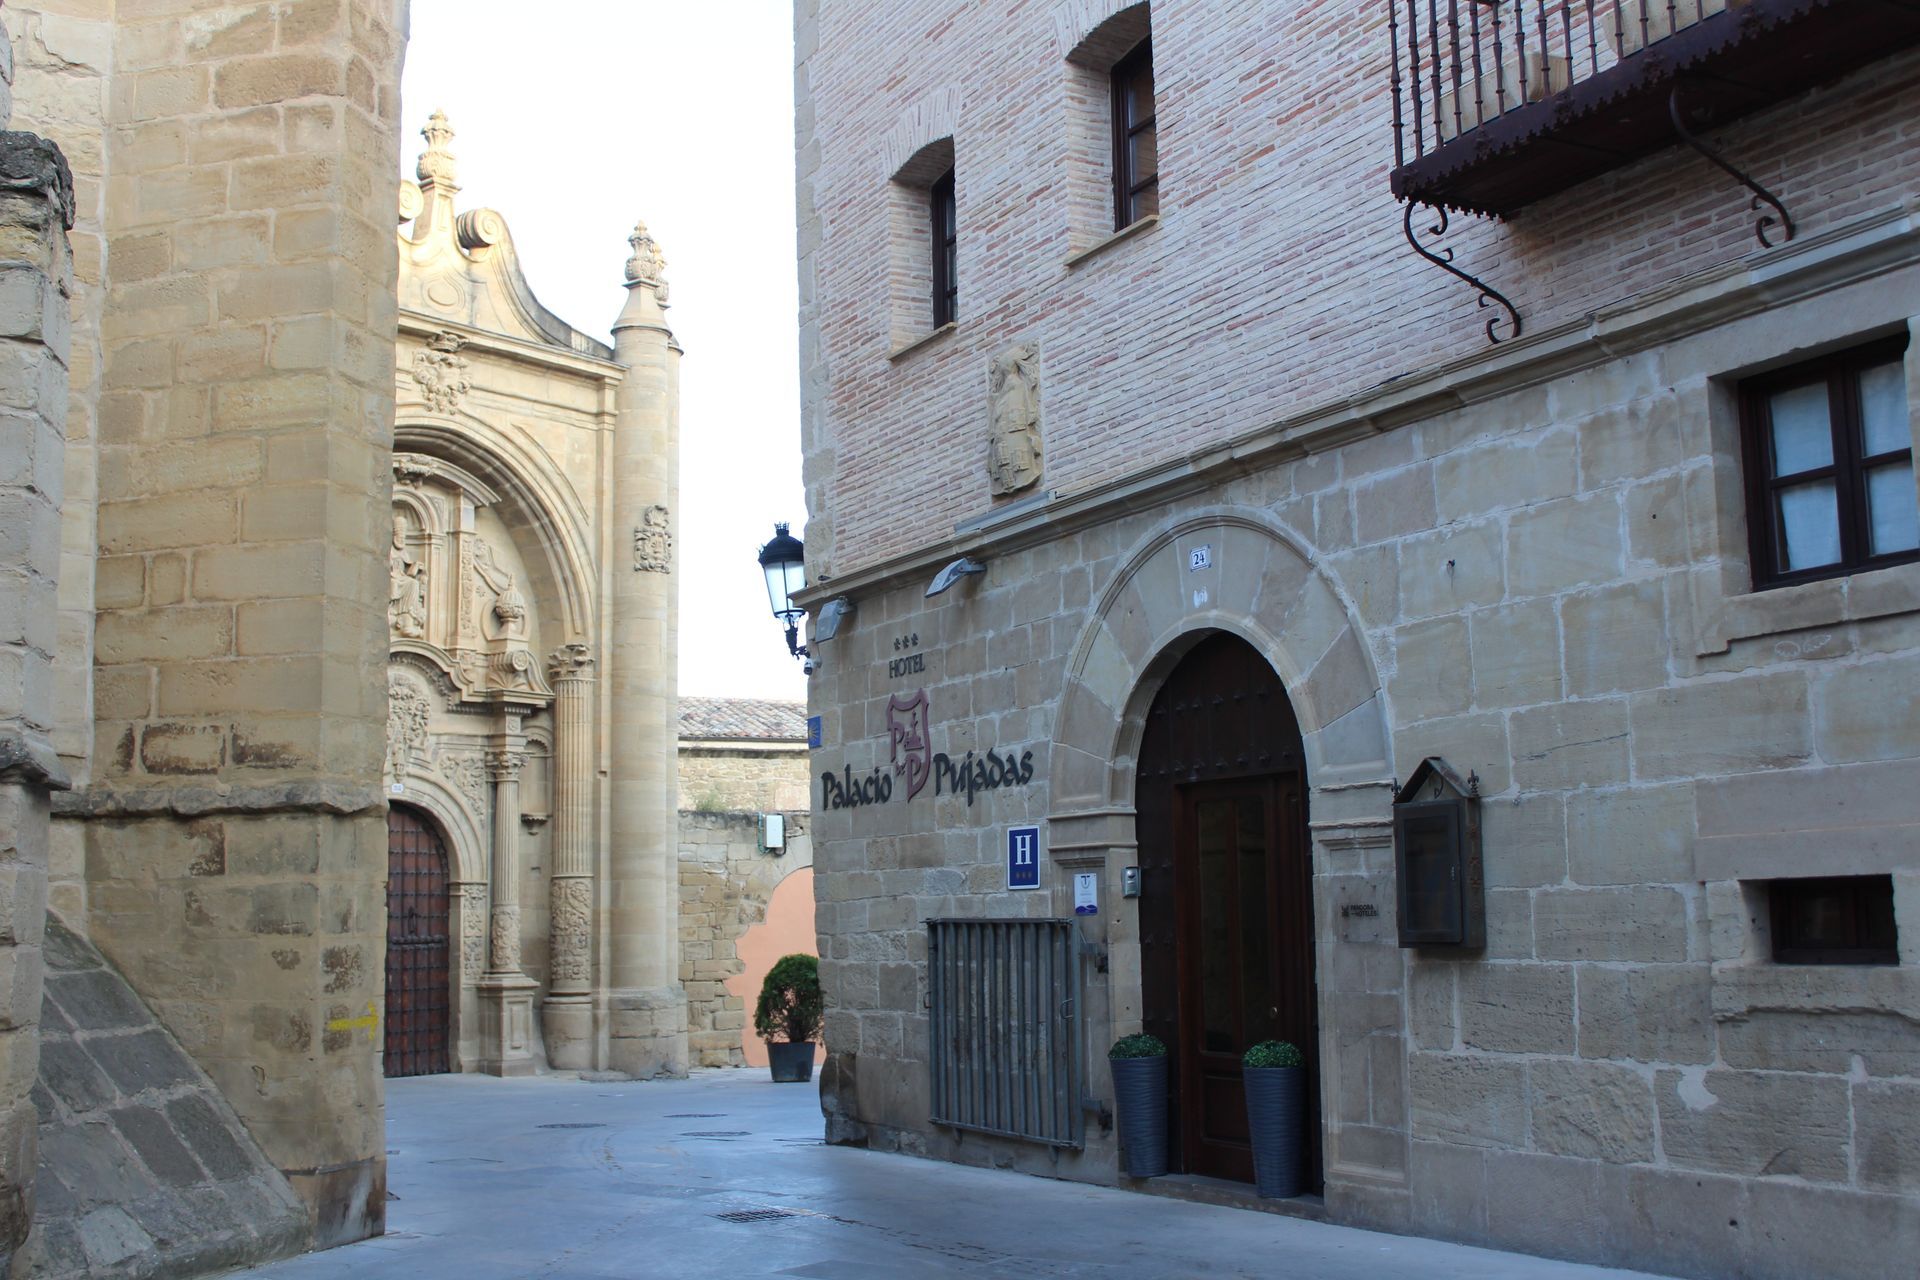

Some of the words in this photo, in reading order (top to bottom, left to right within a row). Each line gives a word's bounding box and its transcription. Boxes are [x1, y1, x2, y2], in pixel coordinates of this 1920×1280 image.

[1193, 553, 1205, 565] 24
[889, 653, 925, 679] HOTEL
[821, 763, 893, 811] Palacio
[933, 748, 1034, 807] Pujadas
[1015, 834, 1032, 865] H
